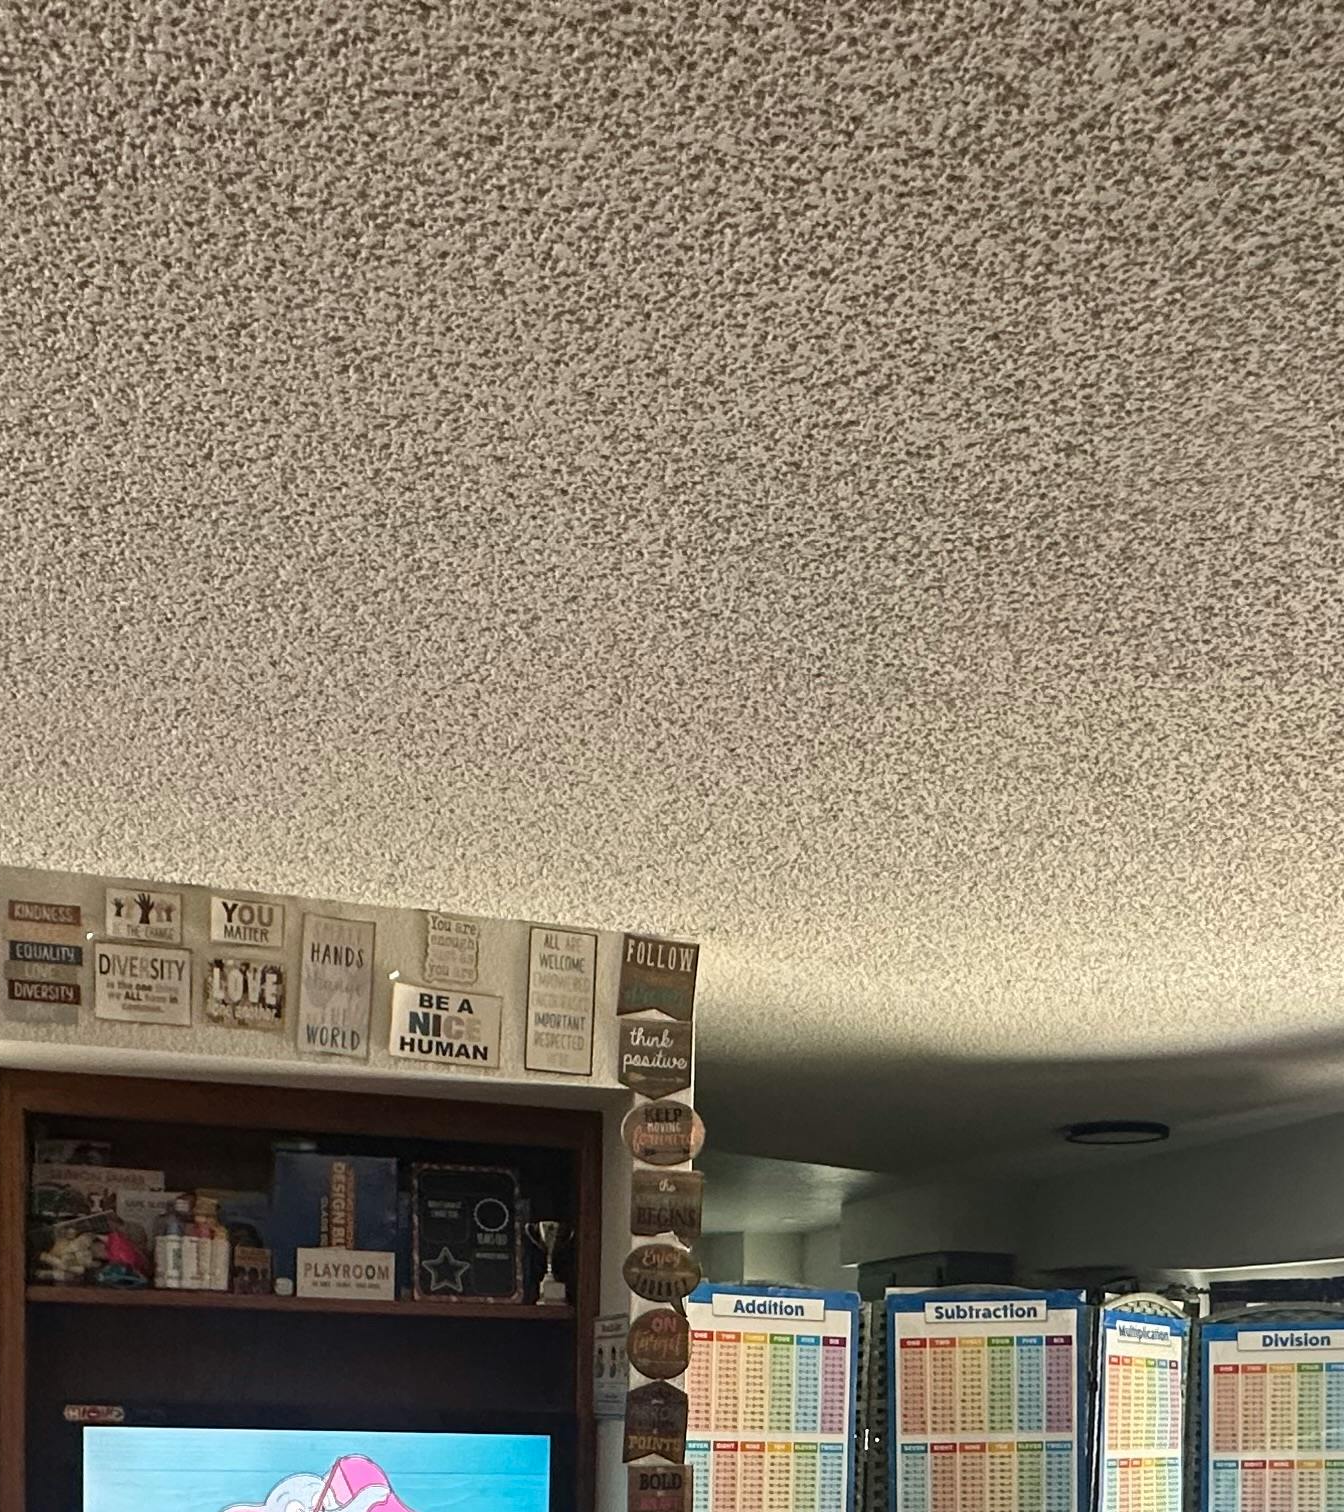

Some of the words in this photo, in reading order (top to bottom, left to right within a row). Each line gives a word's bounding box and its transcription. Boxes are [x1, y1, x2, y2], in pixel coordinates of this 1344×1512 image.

[14, 903, 73, 921] KINDNESS
[222, 901, 274, 926] YOU
[127, 923, 142, 937] THE
[224, 925, 269, 943] MATTER
[431, 916, 451, 932] You
[456, 923, 477, 935] are
[430, 934, 475, 949] enough
[544, 934, 560, 950] ALL
[16, 944, 75, 960] EQUALITY
[311, 942, 364, 969] HANDS
[626, 938, 695, 972] FOLLOW
[99, 953, 185, 981] DIVERSITY
[539, 953, 585, 973] WELCOME
[14, 983, 75, 1000] DIVERSITY
[213, 966, 279, 1005] LOVE
[124, 991, 143, 1001] ALL
[419, 993, 449, 1011] BE
[458, 999, 474, 1014] A
[409, 1011, 481, 1042] NICE
[534, 1012, 586, 1032] IMPORTANT
[307, 1024, 360, 1050] WORLD
[534, 1033, 584, 1051] RESPECTED
[630, 1027, 674, 1047] think
[399, 1036, 488, 1061] HUMAN
[622, 1050, 687, 1073] positive
[644, 1108, 683, 1122] KEEP
[646, 1122, 681, 1133] MOVING
[331, 1161, 346, 1224] DESIGN
[637, 1207, 697, 1226] BEGINS
[642, 1250, 682, 1268] Enjoy
[303, 1263, 390, 1281] PLAYROOM
[733, 1299, 805, 1318] Addition
[934, 1303, 1038, 1321] Subtraction
[1118, 1324, 1169, 1343] Multiplication
[1261, 1333, 1331, 1348] Division
[639, 1473, 682, 1491] BOLD
